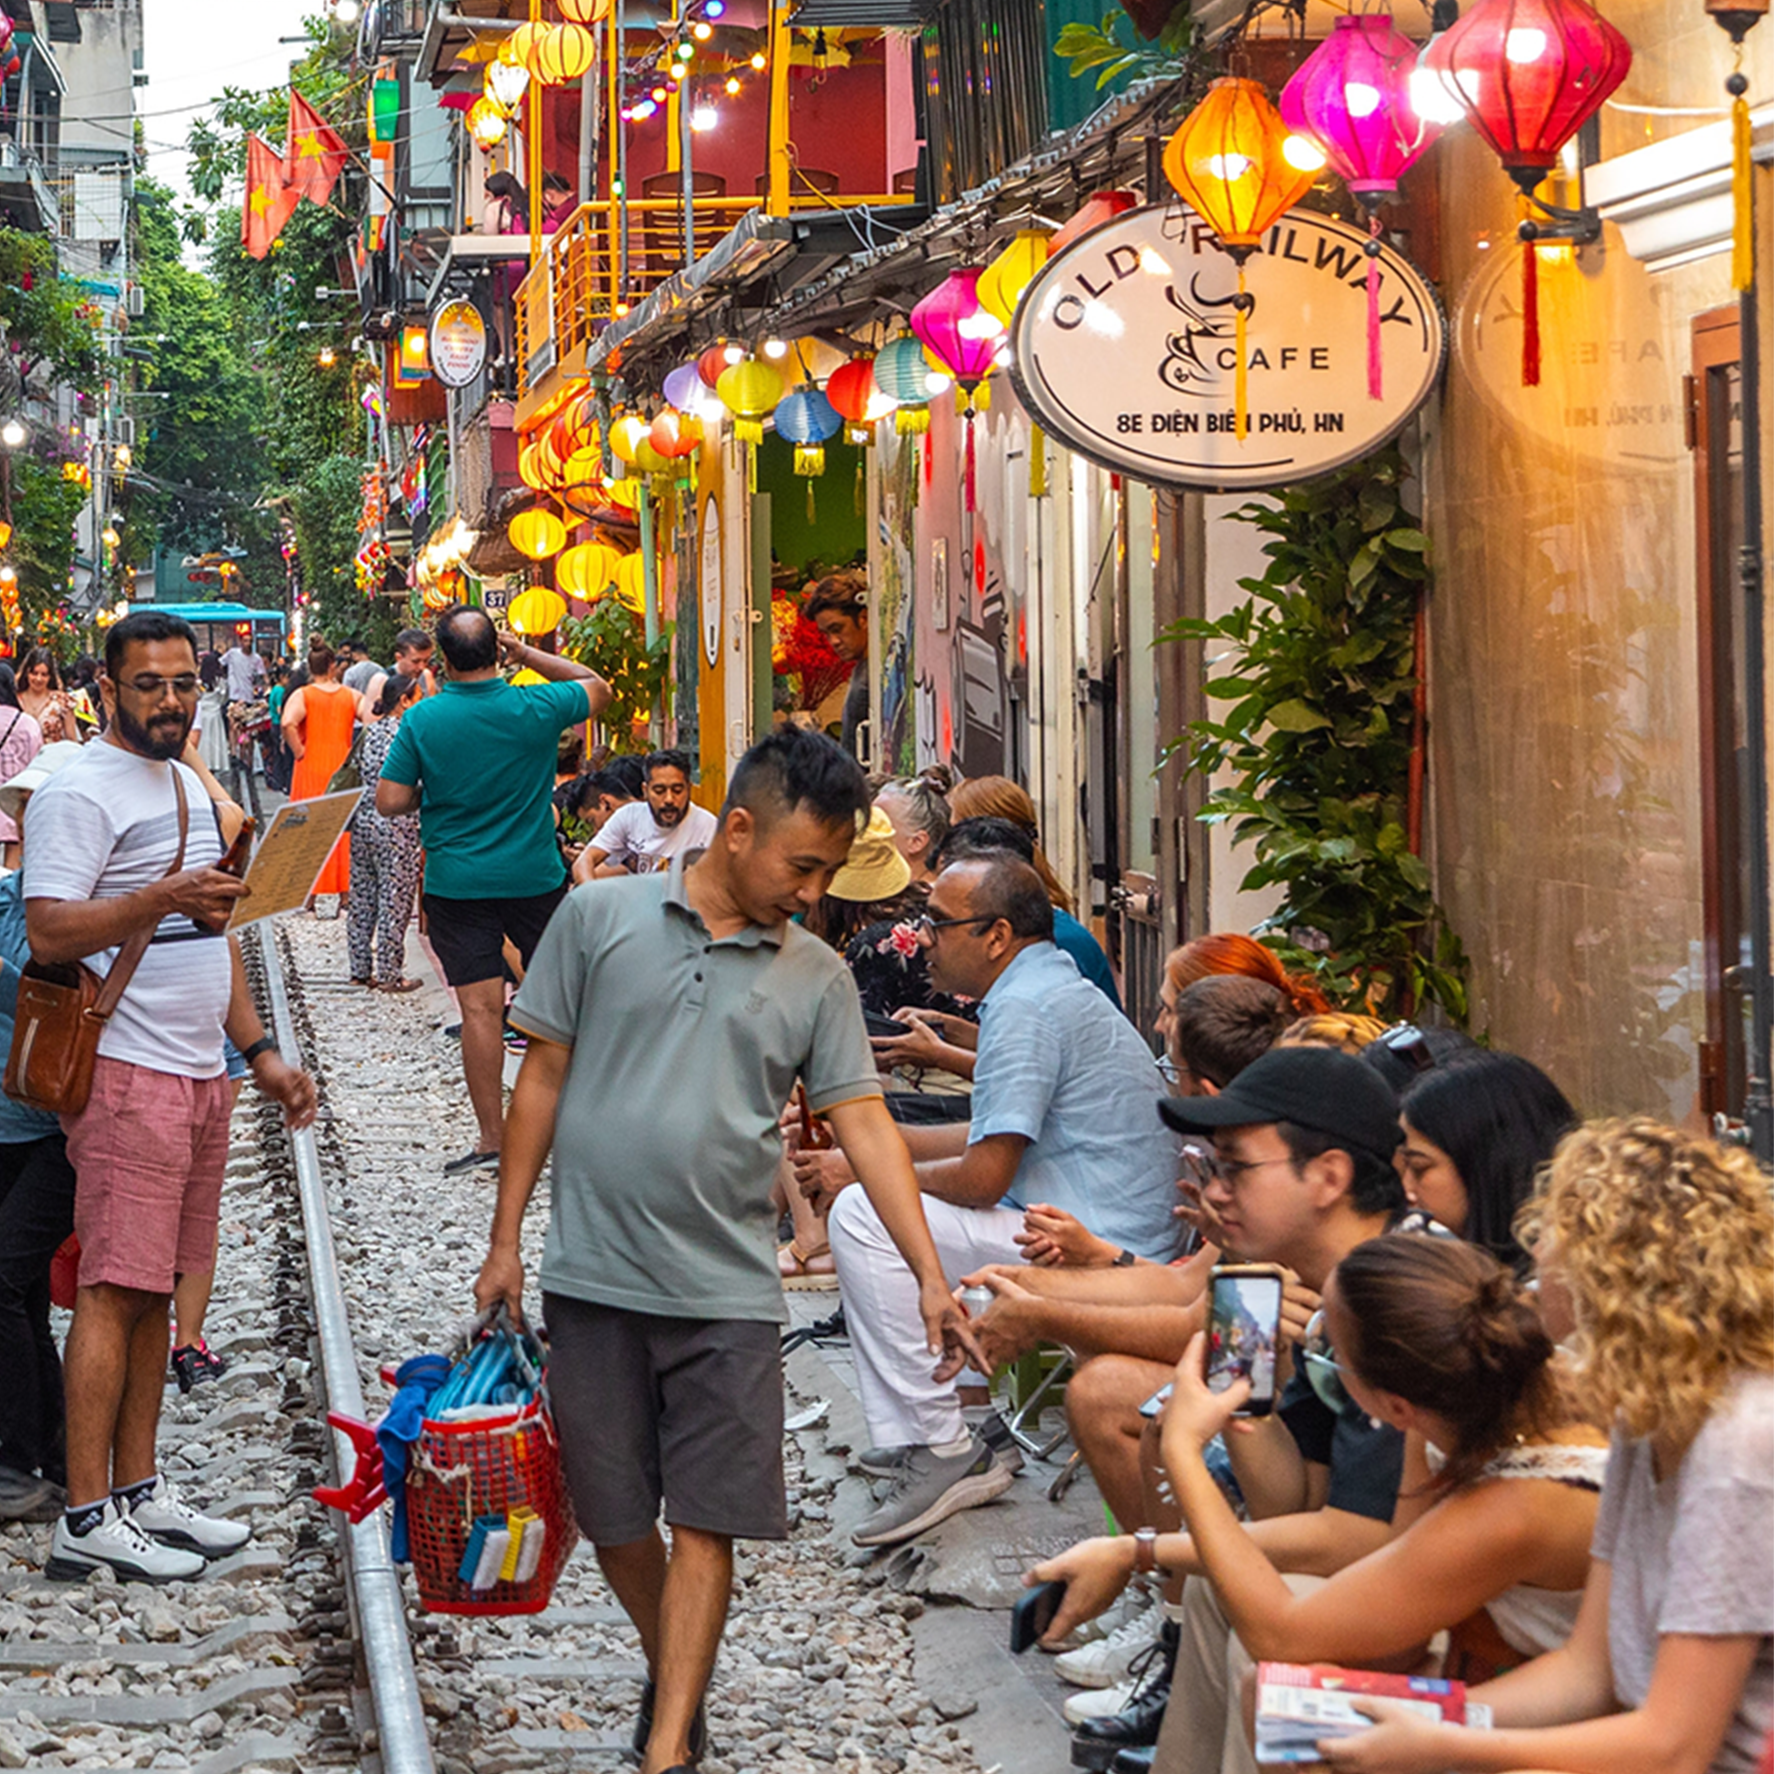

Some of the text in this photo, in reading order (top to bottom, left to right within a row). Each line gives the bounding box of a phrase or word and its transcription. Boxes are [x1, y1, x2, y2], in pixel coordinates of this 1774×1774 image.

[1052, 223, 1413, 331] OLD RILWAY
[1216, 347, 1330, 371] CAFE
[1116, 406, 1344, 437] 8E ĐIỆN BIÊ PHỦ, HN
[487, 591, 505, 607] 37
